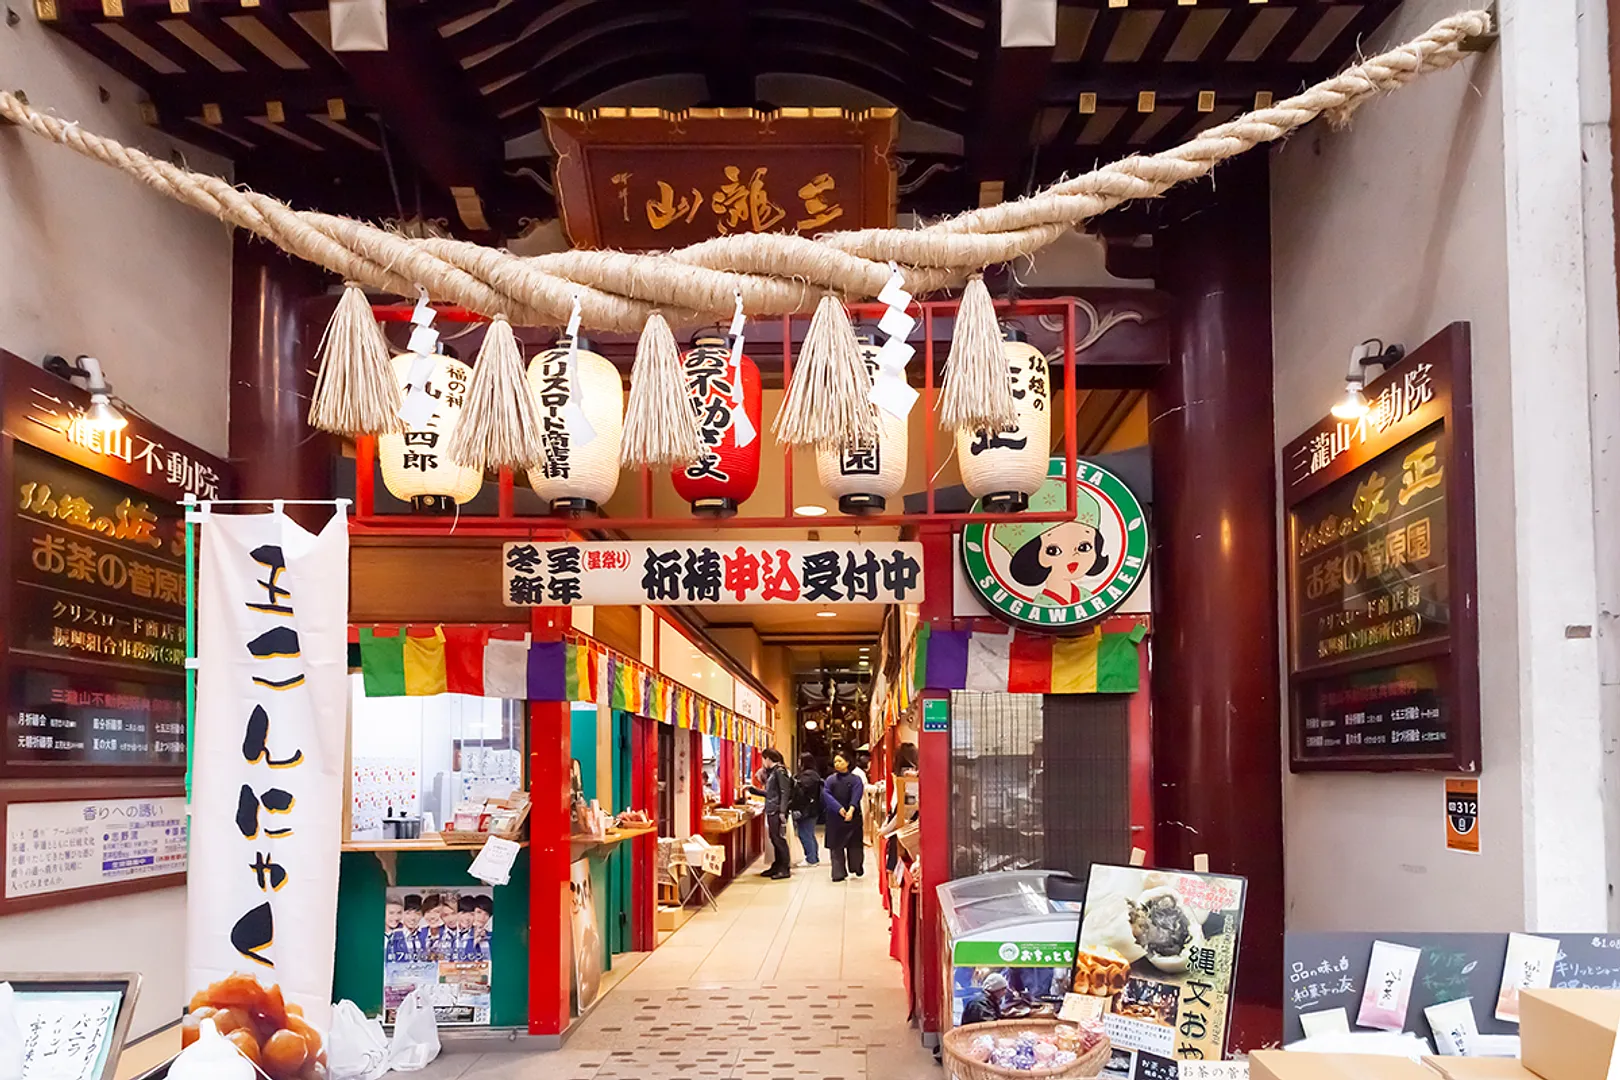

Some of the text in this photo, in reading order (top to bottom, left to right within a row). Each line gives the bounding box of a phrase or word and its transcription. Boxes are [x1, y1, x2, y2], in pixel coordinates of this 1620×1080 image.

[1028, 355, 1047, 412] 仏壇の
[541, 350, 572, 480] クリスロード商店街
[506, 545, 632, 575] 冬至 (星祭り)
[641, 546, 922, 603] 祈祷申込受付中
[509, 576, 583, 604] 新年
[980, 554, 1142, 624] SUGAWARAEN
[83, 803, 164, 821] 香りへの誘い
